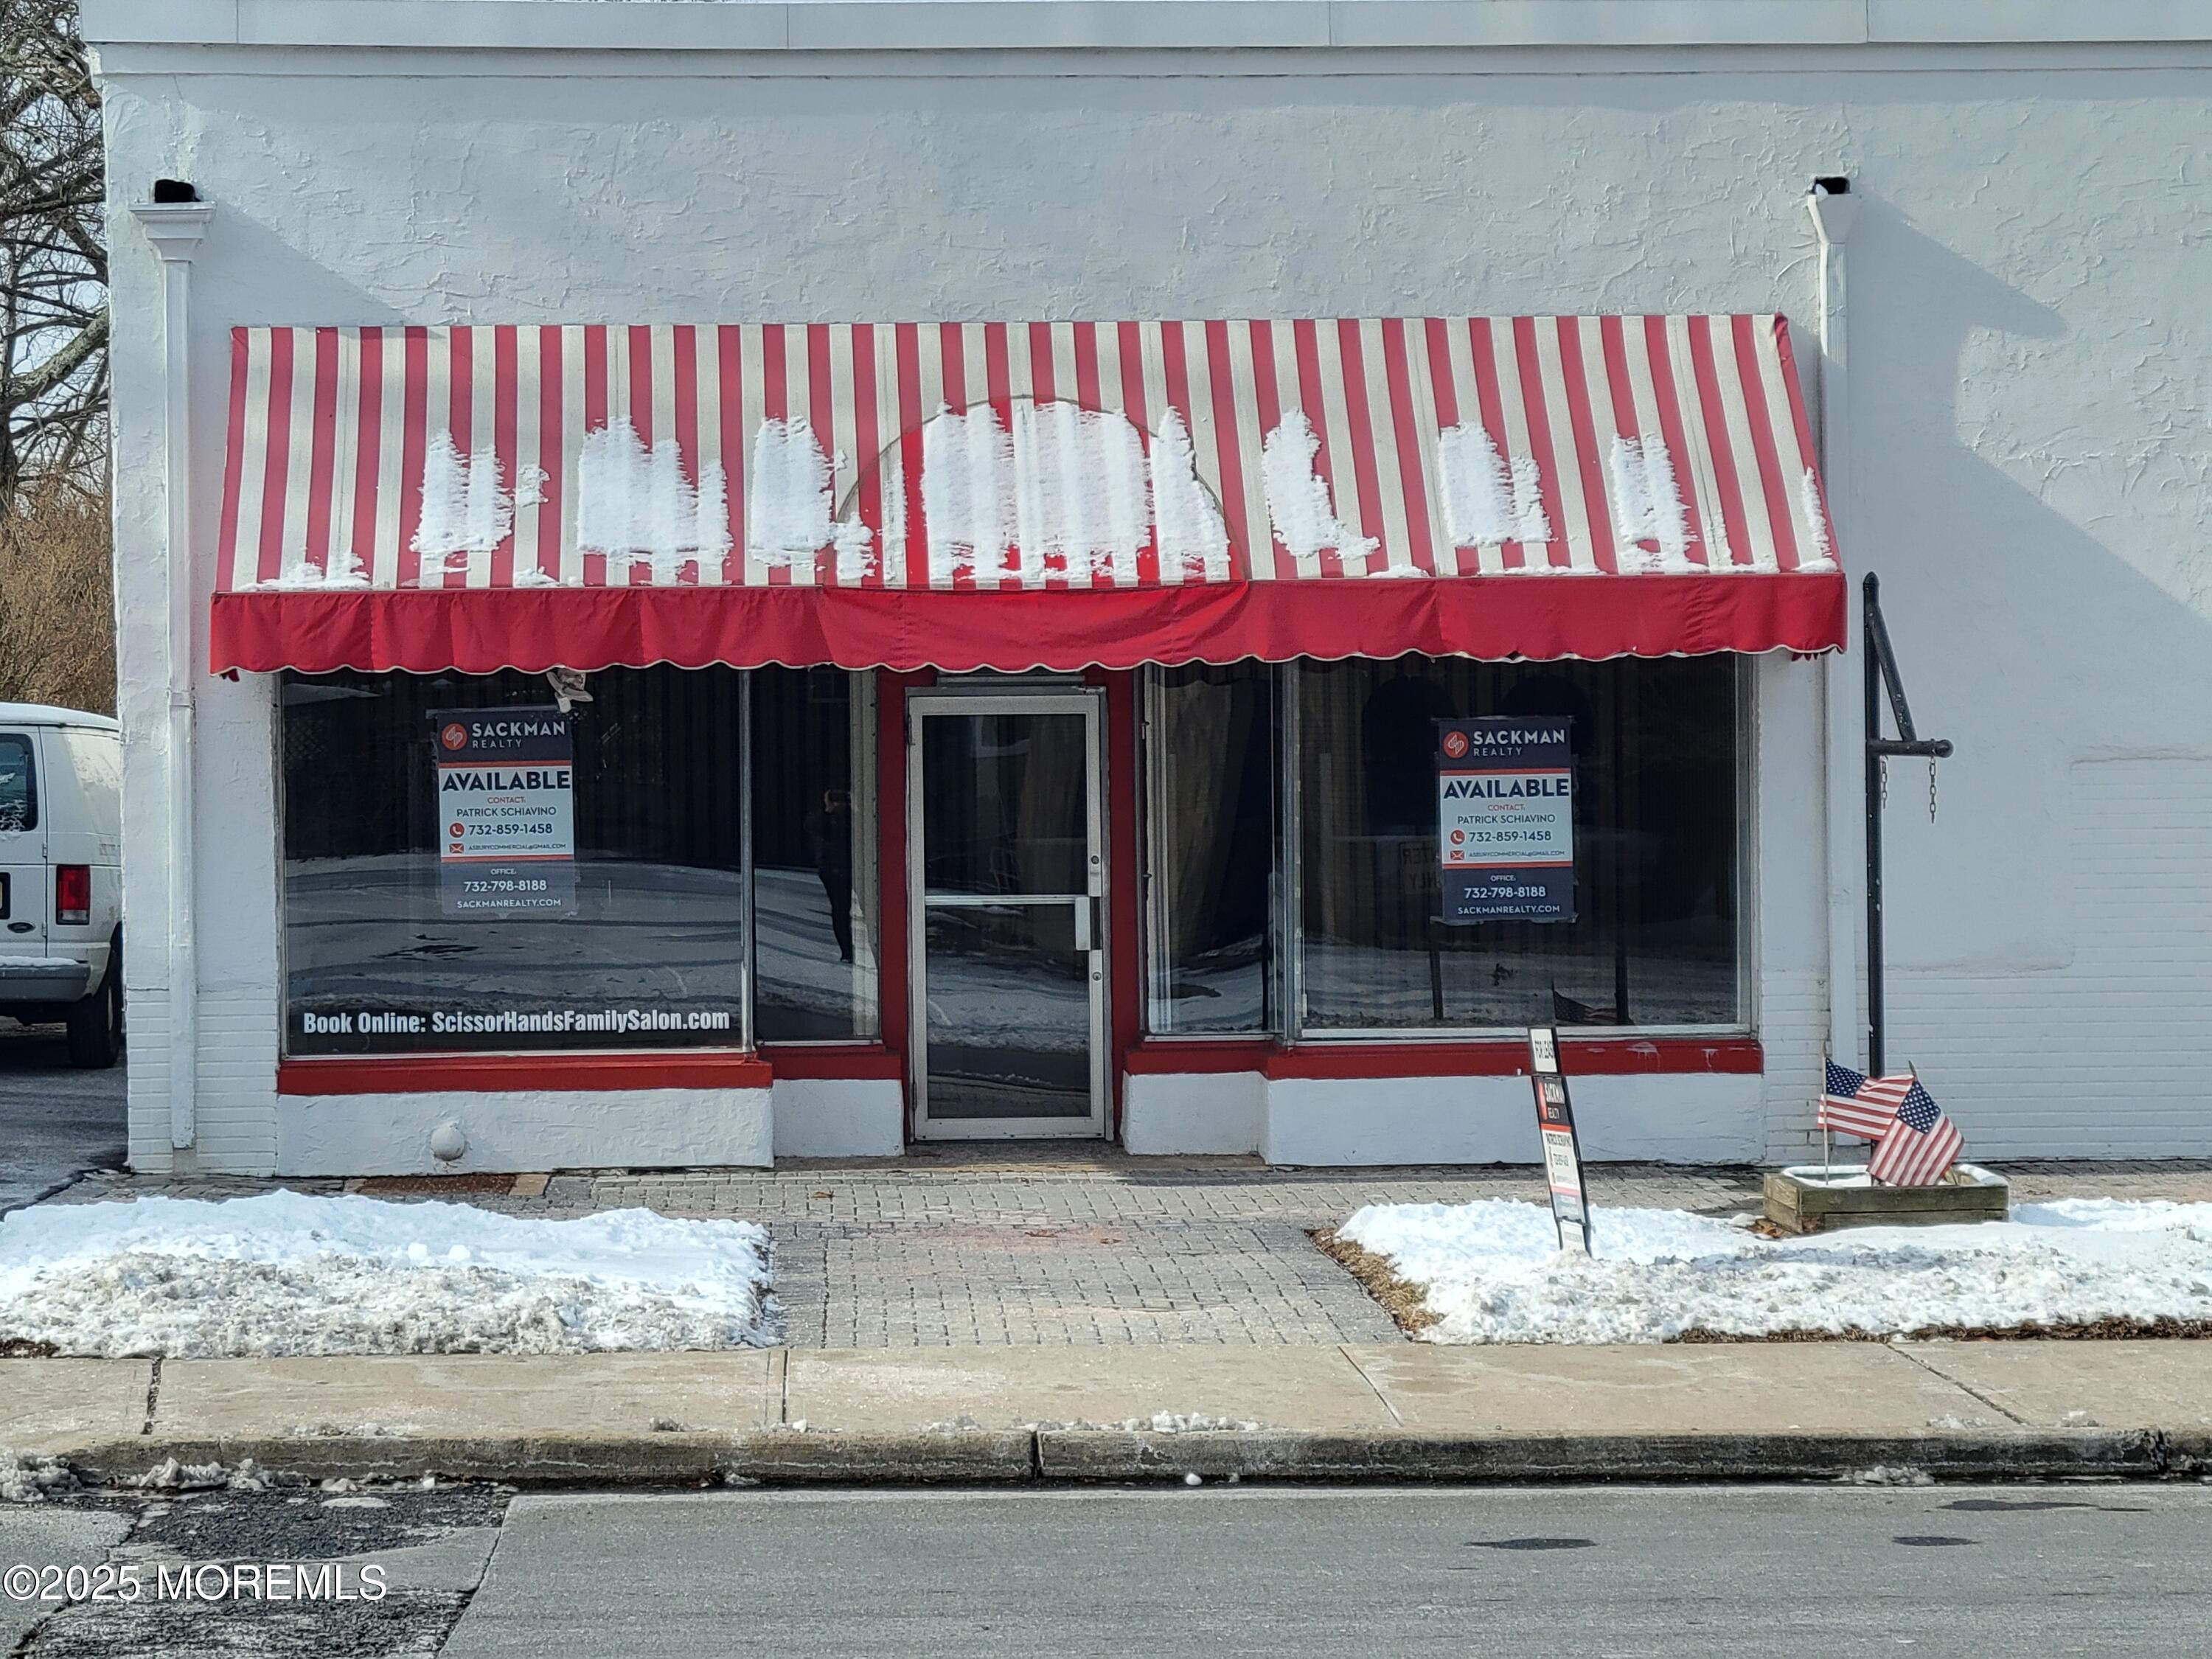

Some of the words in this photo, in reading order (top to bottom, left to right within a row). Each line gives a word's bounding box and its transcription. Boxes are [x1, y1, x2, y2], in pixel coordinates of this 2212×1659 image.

[472, 720, 566, 738] SACKMAN
[1473, 728, 1565, 745] SACKMAN
[473, 739, 522, 749] REALTY
[1474, 747, 1523, 757] REALTY
[442, 771, 571, 792] AVAILABLE
[1443, 778, 1569, 799] AVAILABLE
[456, 807, 498, 817] PATRICK
[501, 807, 557, 816] SCHIAVINO
[1458, 815, 1498, 824] PATRICK
[1500, 814, 1556, 824] SCHIAVINO
[468, 823, 553, 836] 732-859-1458
[1469, 830, 1552, 843] 732-859-1458
[464, 880, 547, 892] 732-798-8188
[1464, 886, 1547, 899] 732-798-8188
[457, 899, 562, 909] SACKMANREALTY.COM
[1458, 905, 1561, 915] SACKMANREALTY.COM
[303, 1012, 352, 1034] Book
[358, 1012, 427, 1034] Online:
[432, 1009, 730, 1033] ScissorHandsFamilySalon.com
